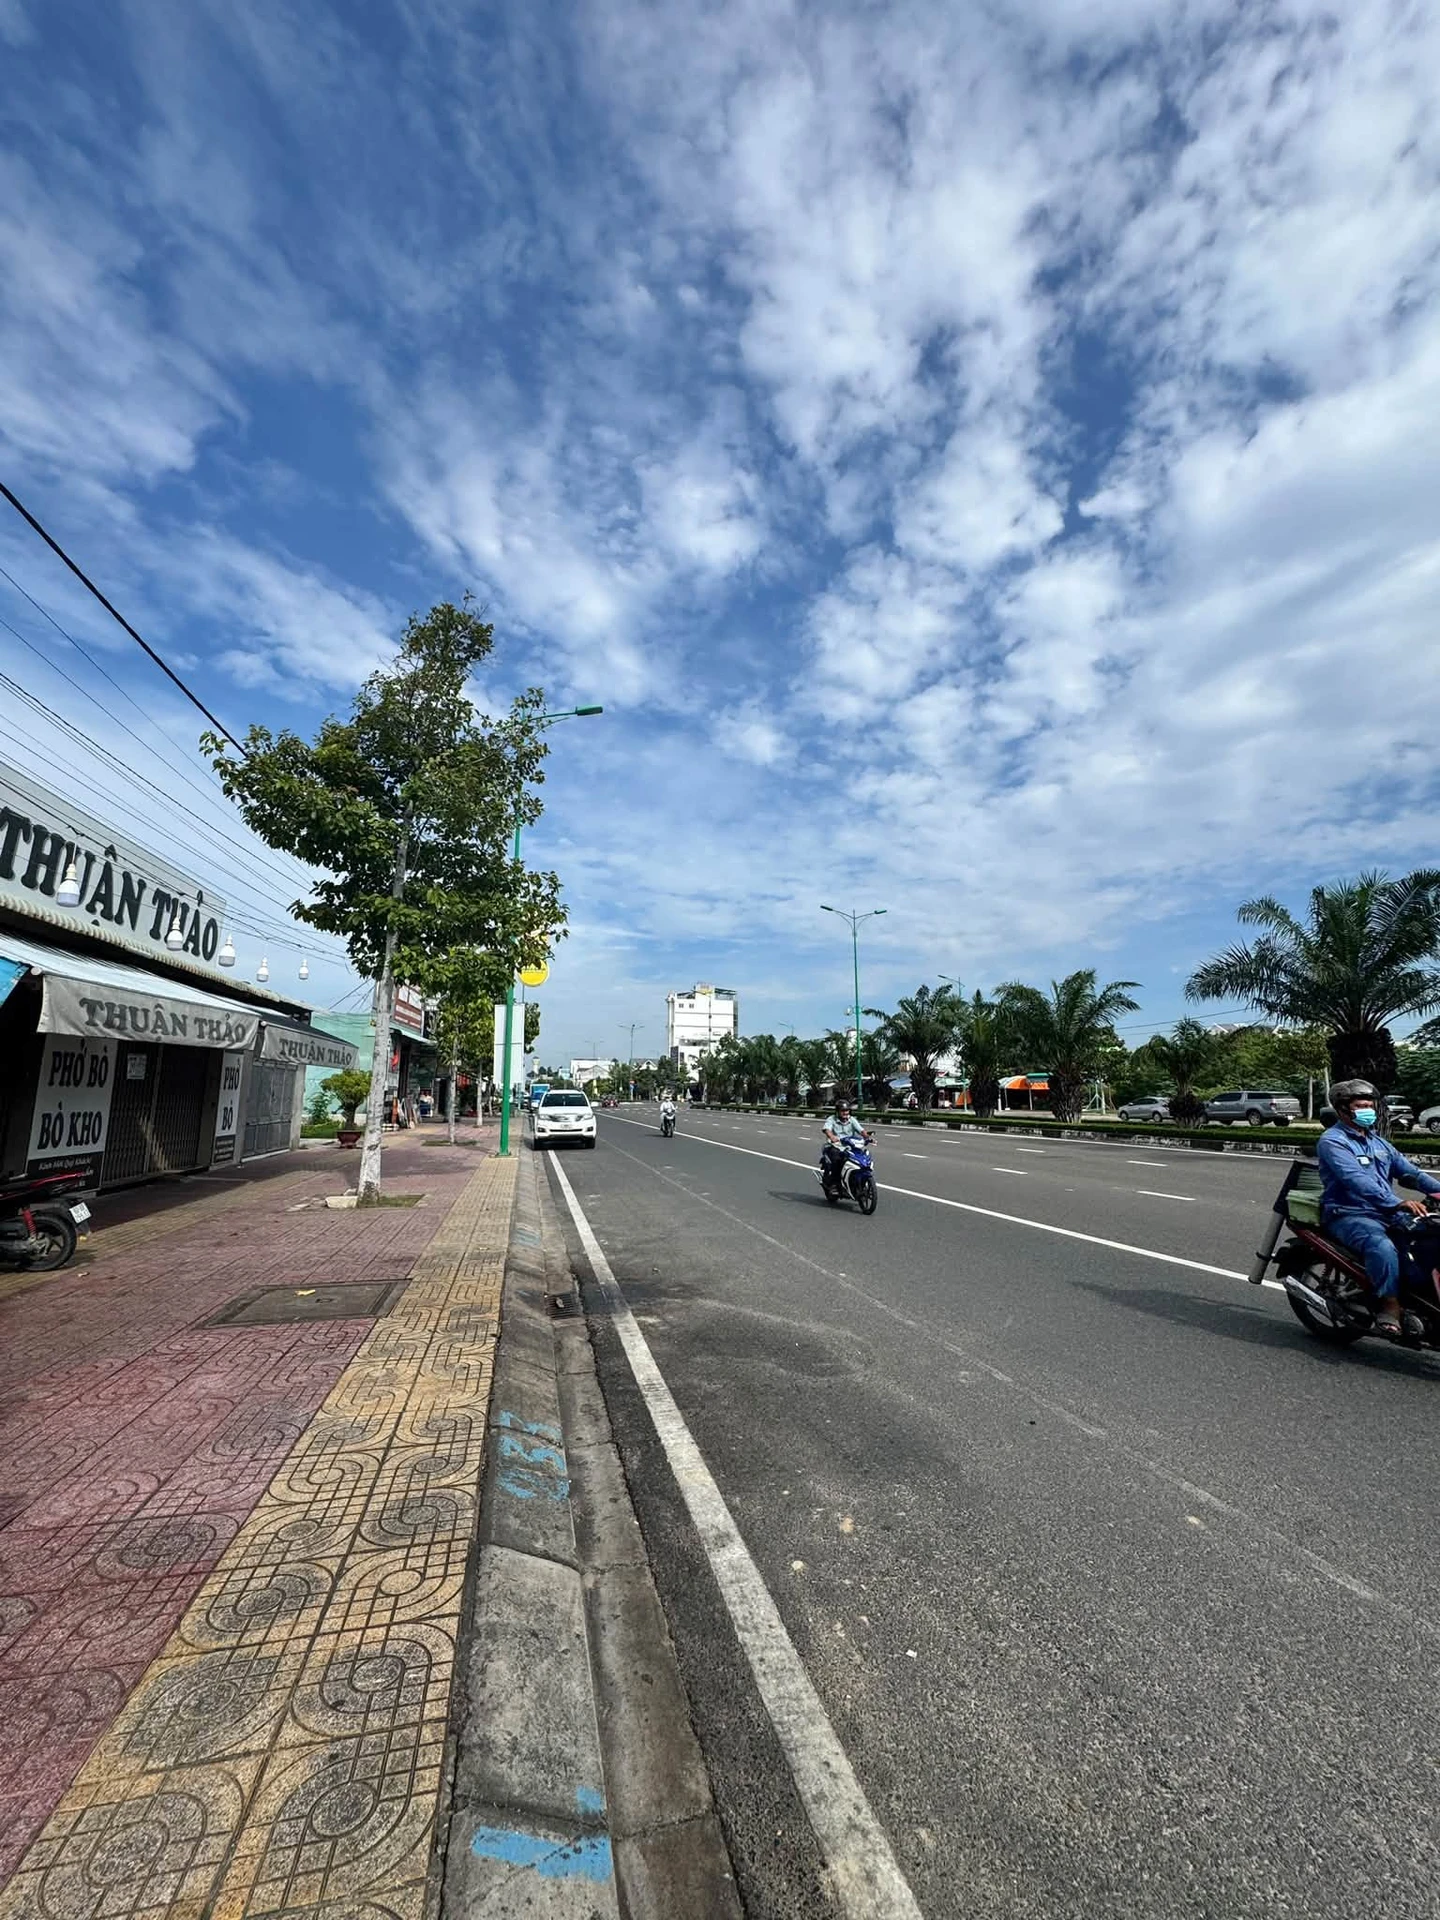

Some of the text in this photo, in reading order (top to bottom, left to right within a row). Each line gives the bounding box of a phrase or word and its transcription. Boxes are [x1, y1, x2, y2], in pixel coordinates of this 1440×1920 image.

[0, 806, 147, 927] THUẬN
[79, 997, 247, 1043] THUẬN THẢO
[48, 1038, 87, 1087] PHỞ
[86, 1045, 109, 1088] BÒ
[280, 1038, 352, 1066] THUẬN THẢO
[37, 1101, 102, 1150] BÒ KHO
[221, 1101, 233, 1131] BÒ
